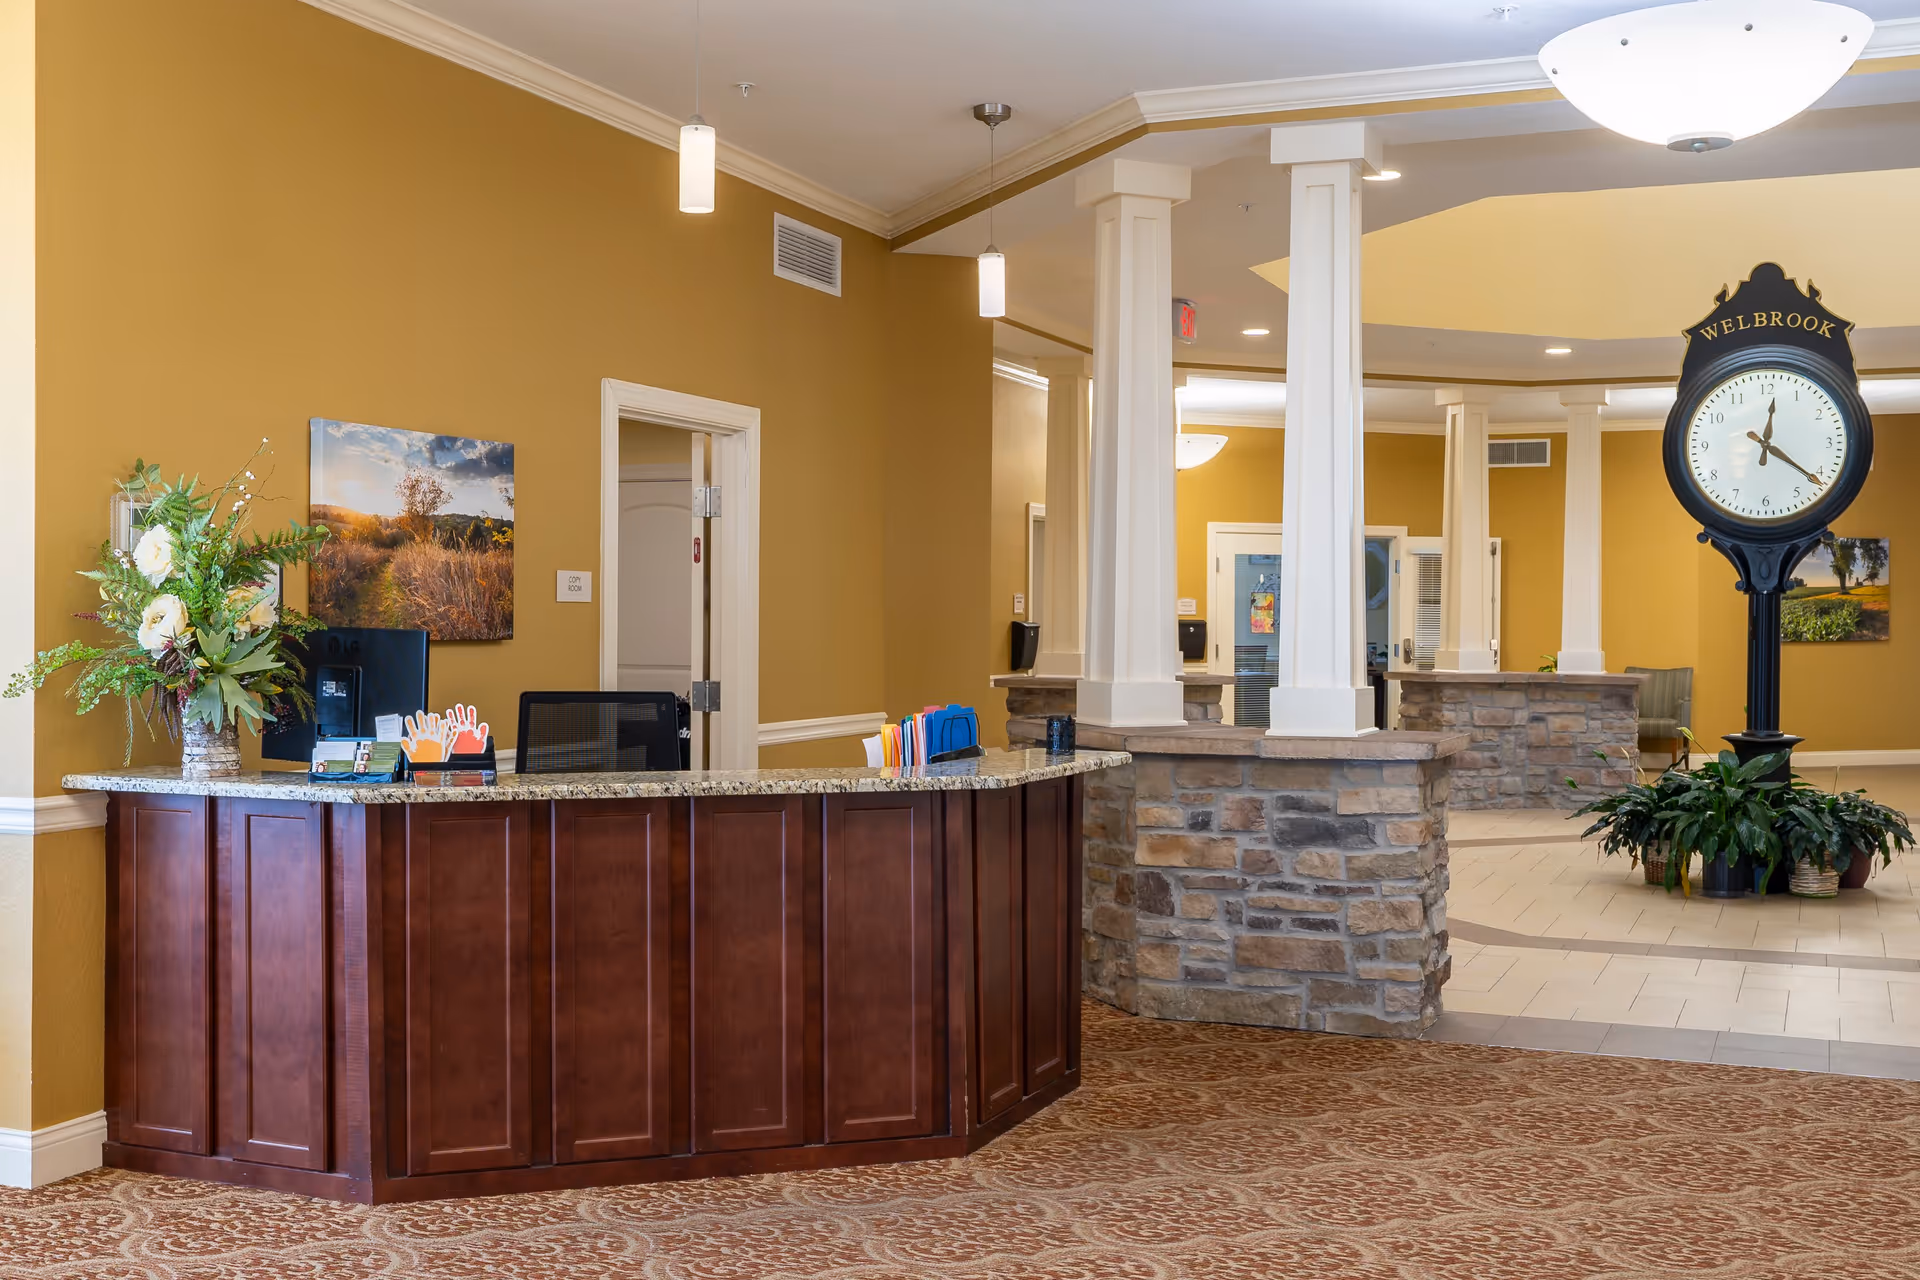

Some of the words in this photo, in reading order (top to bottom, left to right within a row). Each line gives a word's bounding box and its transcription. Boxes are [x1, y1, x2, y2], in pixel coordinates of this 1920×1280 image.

[1699, 311, 1836, 341] WELBROOK
[1760, 383, 1774, 395] 12
[1731, 393, 1743, 404] 11
[1710, 412, 1724, 424] 10
[1815, 408, 1823, 420] 2
[1701, 441, 1709, 452] 9
[1825, 437, 1833, 448] 3
[1710, 469, 1718, 481] 8
[1815, 465, 1824, 477] 4
[1732, 488, 1739, 500] 7
[1793, 486, 1800, 498] 5
[1762, 495, 1770, 507] 6
